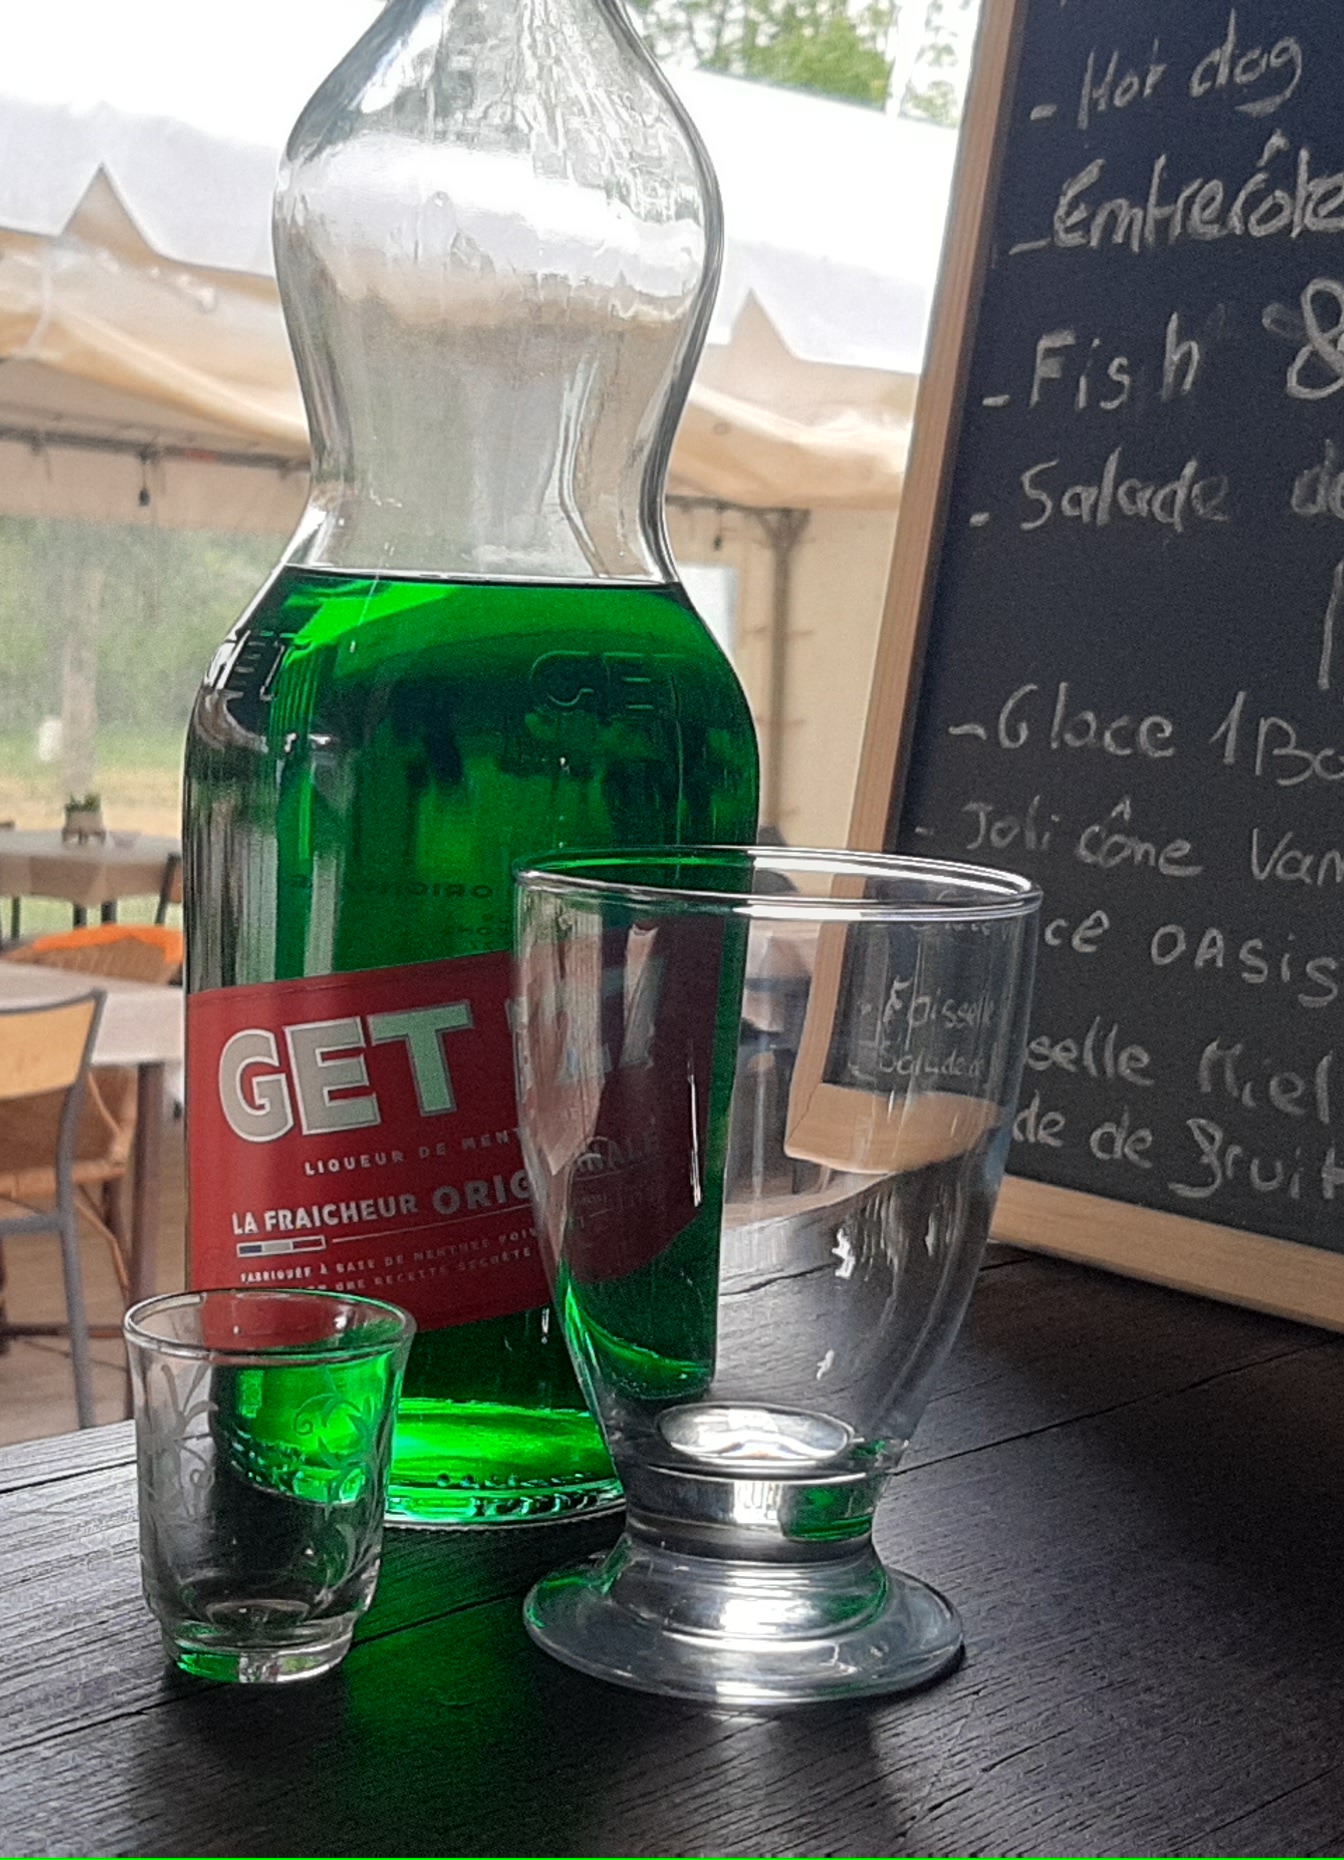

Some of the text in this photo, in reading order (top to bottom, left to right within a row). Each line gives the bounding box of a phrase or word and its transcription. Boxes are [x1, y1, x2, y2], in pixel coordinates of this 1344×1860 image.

[1188, 7, 1303, 118] dog
[217, 1000, 475, 1145] GET
[1198, 1036, 1334, 1125] Miel
[303, 1125, 527, 1177] LIQUEUR DE MENT
[1089, 1104, 1154, 1170] de
[231, 1210, 259, 1237] LA
[263, 1192, 420, 1234] FRAICHEUR
[384, 1253, 405, 1268] DE
